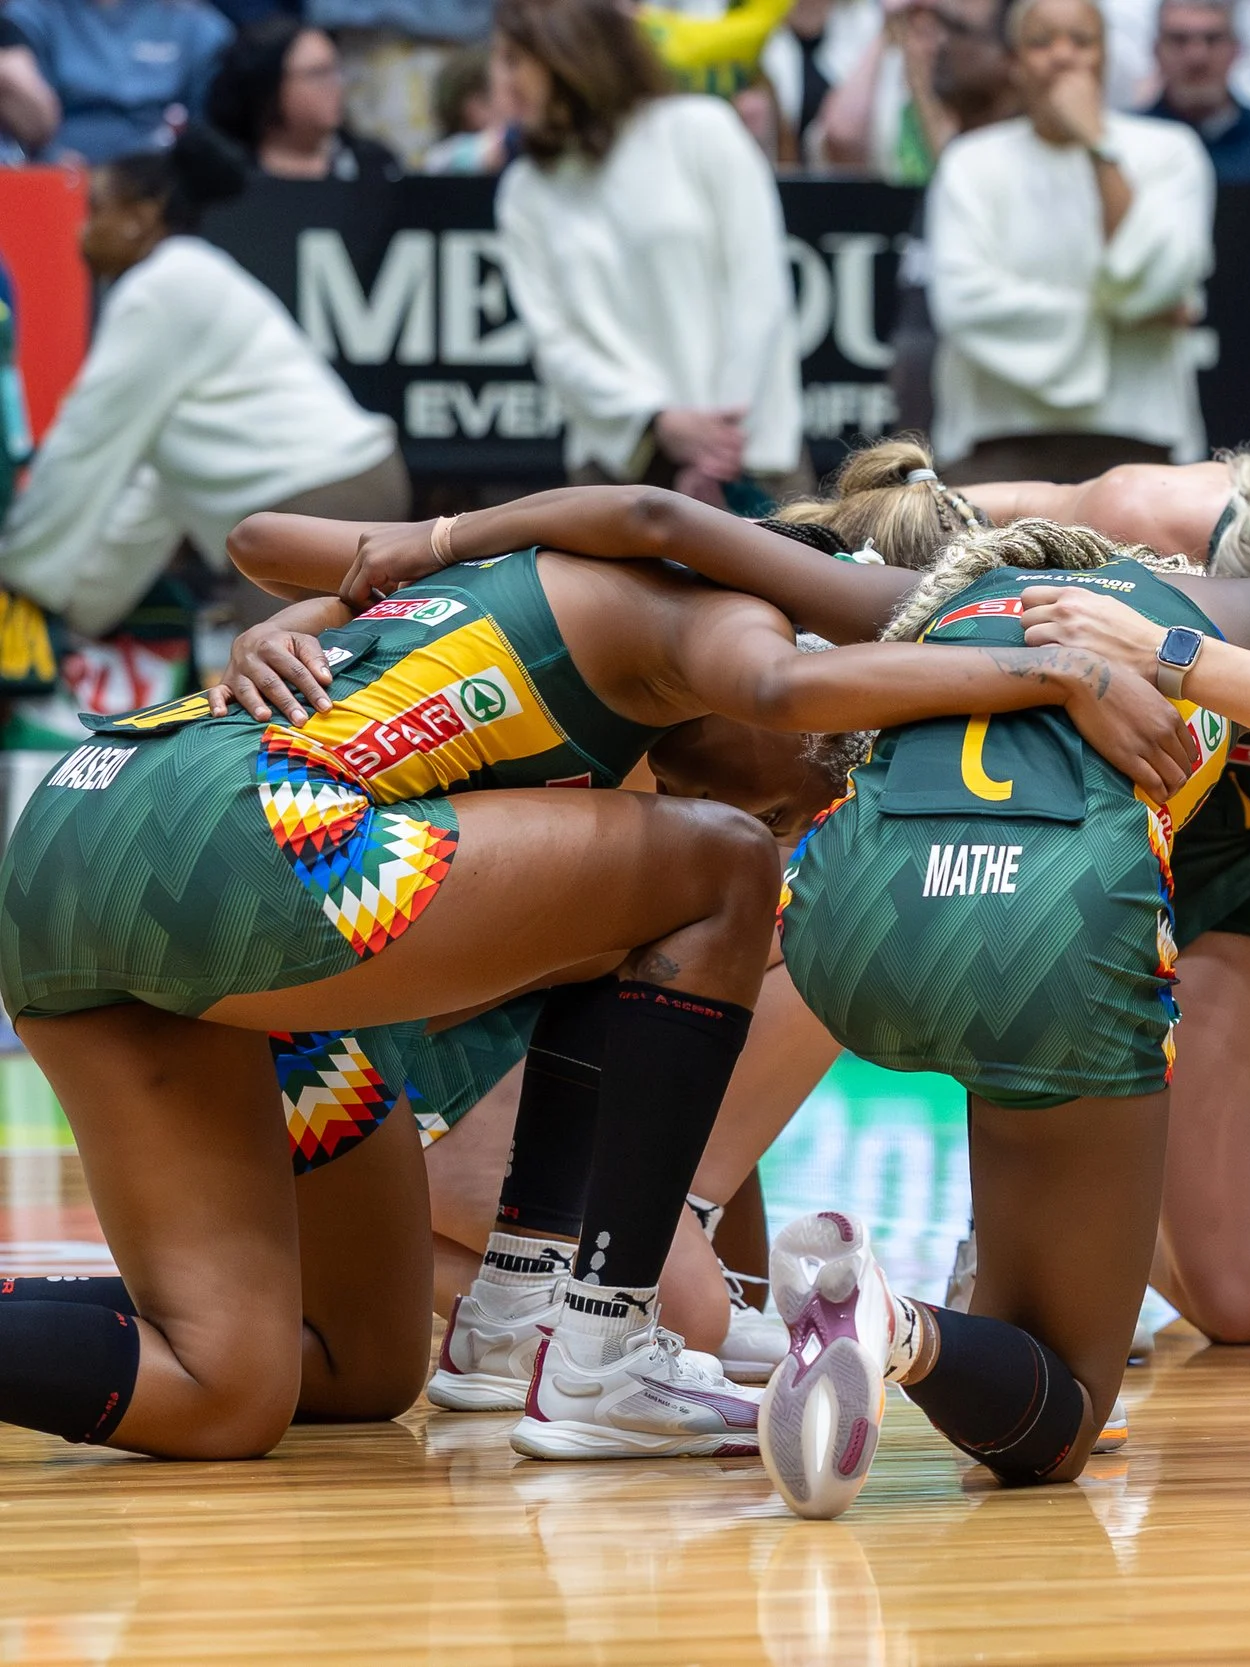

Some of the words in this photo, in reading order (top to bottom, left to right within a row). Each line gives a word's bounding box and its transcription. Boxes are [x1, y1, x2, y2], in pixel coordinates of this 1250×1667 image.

[1015, 574, 1137, 590] HOLLYWOOD
[47, 745, 138, 790] MASEKO
[922, 844, 1023, 897] MATHE
[484, 1250, 556, 1274] PUMA
